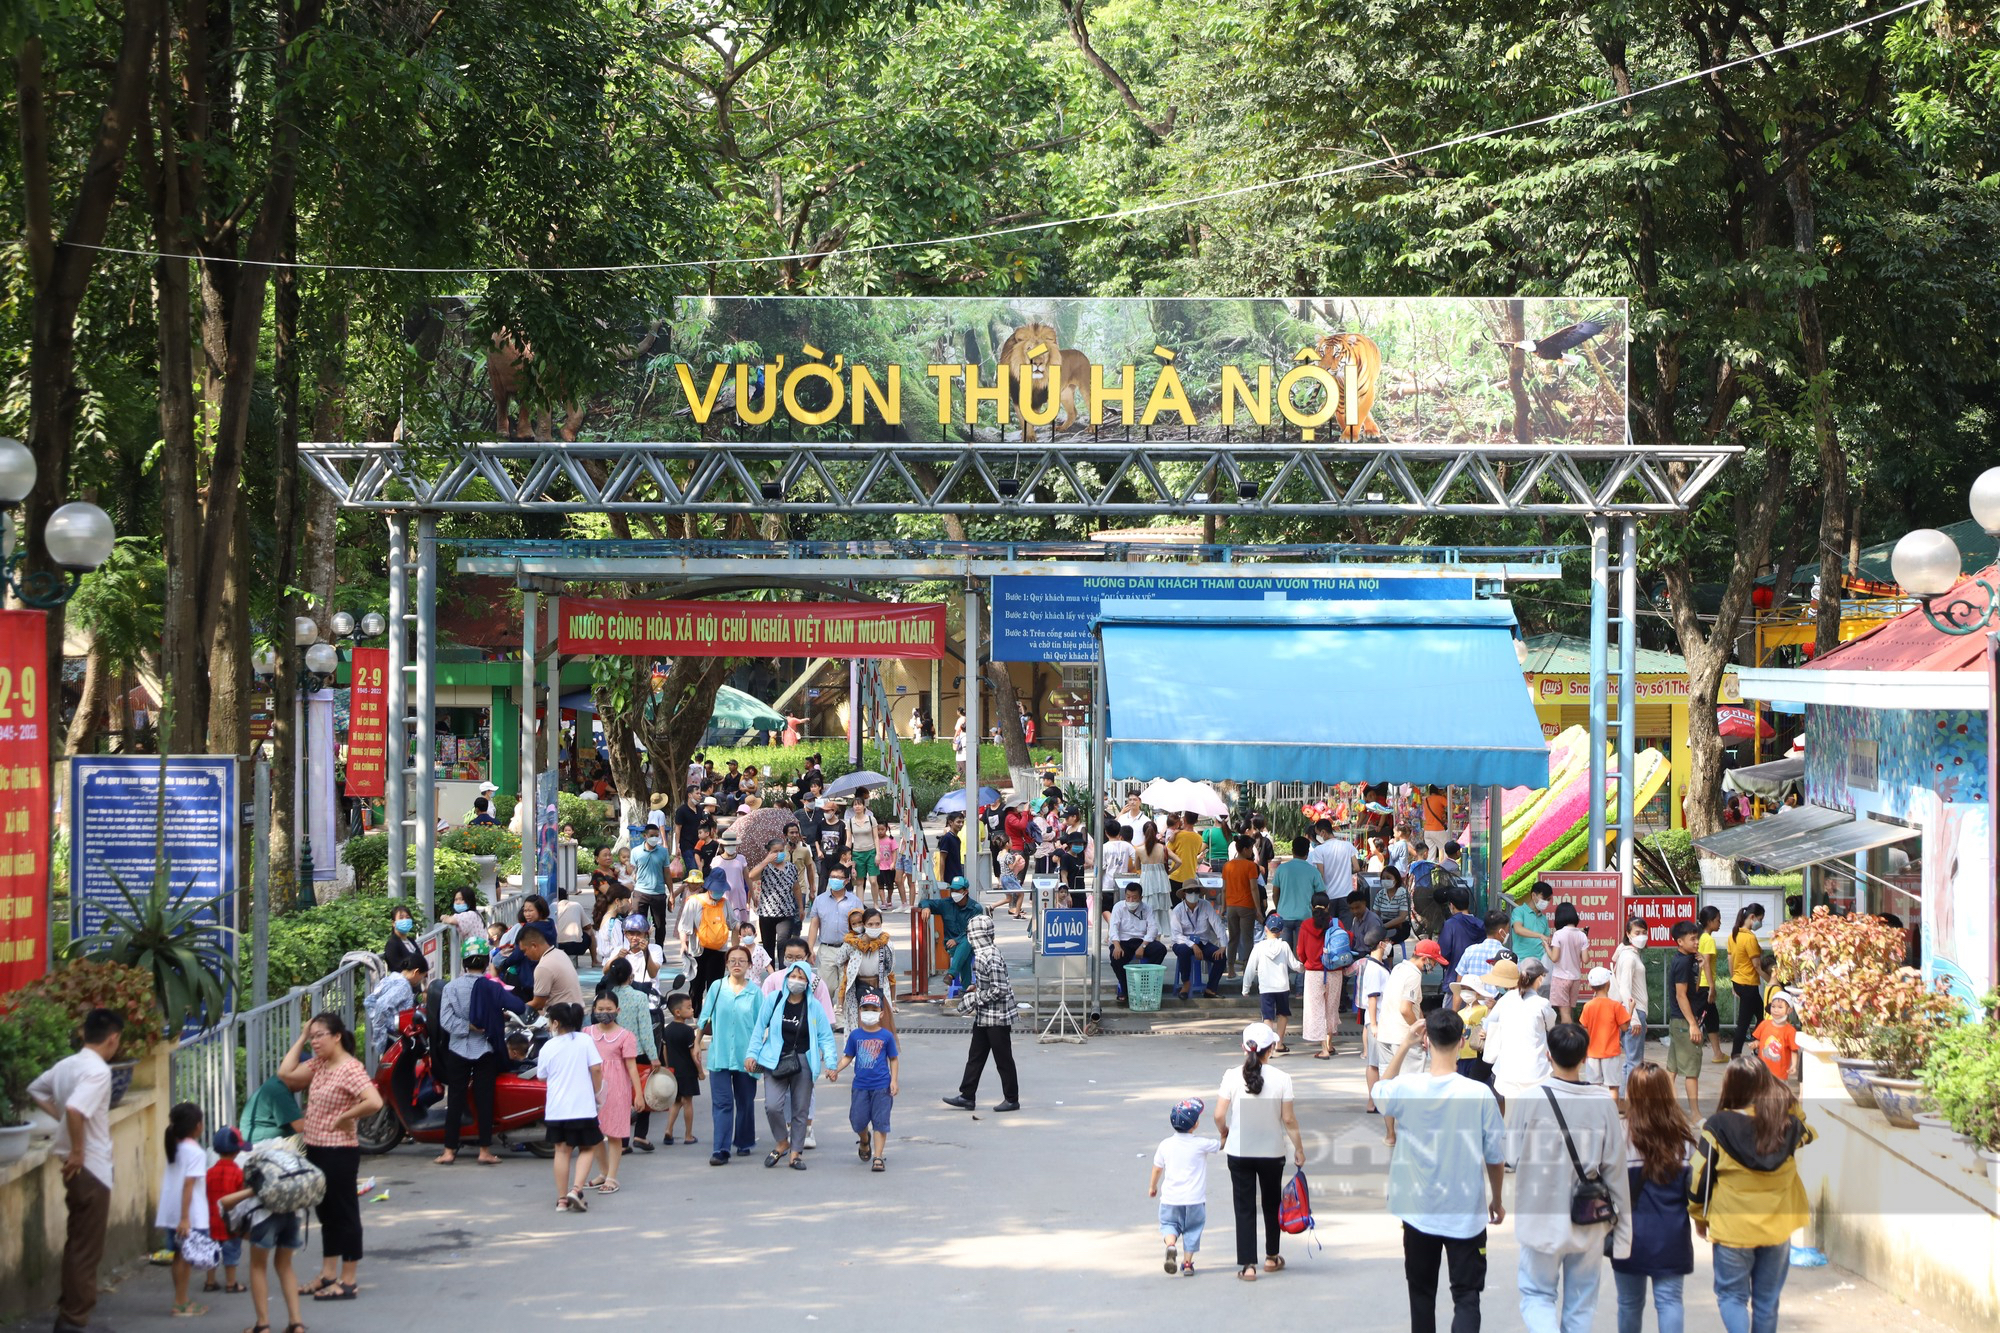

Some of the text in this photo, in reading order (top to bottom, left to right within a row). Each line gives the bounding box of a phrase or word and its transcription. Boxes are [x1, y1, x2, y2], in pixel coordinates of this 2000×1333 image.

[674, 343, 1359, 441] VƯỜN THÚ HÀ NỘI
[1083, 576, 1380, 592] HƯỚNG DẪN KHÁCH THAM QUAN VƯỜN THÚ HÀ NỘI
[1005, 592, 1022, 601] Bước
[1030, 592, 1044, 602] Quý
[1045, 593, 1064, 602] khách
[1082, 594, 1089, 602] vé
[1091, 594, 1100, 604] tại
[1005, 610, 1022, 619] Bước
[1023, 611, 1028, 619] 2:
[1030, 611, 1044, 620] Quý
[1045, 611, 1064, 620] khách
[1066, 610, 1076, 621] lấy
[569, 610, 935, 648] NƯỚC CỘNG HÒA XÃ HỘI CHỦ NGHĨA VIỆT NAM MUÔN NĂM!
[1005, 628, 1022, 637] Bước
[1023, 629, 1028, 637] 3:
[1030, 629, 1045, 638] Trên
[1054, 652, 1068, 661] Quý
[1069, 652, 1088, 660] khách
[358, 667, 382, 686] 2-9
[0, 725, 14, 740] 945
[0, 848, 13, 876] HỦ
[1581, 895, 1608, 906] QUY
[1597, 910, 1614, 921] VIÊN
[1662, 900, 1675, 918] THẢ
[1677, 900, 1692, 918] CHÓ
[1048, 916, 1083, 937] LỐI VÀO
[1651, 925, 1670, 942] VƯỜN
